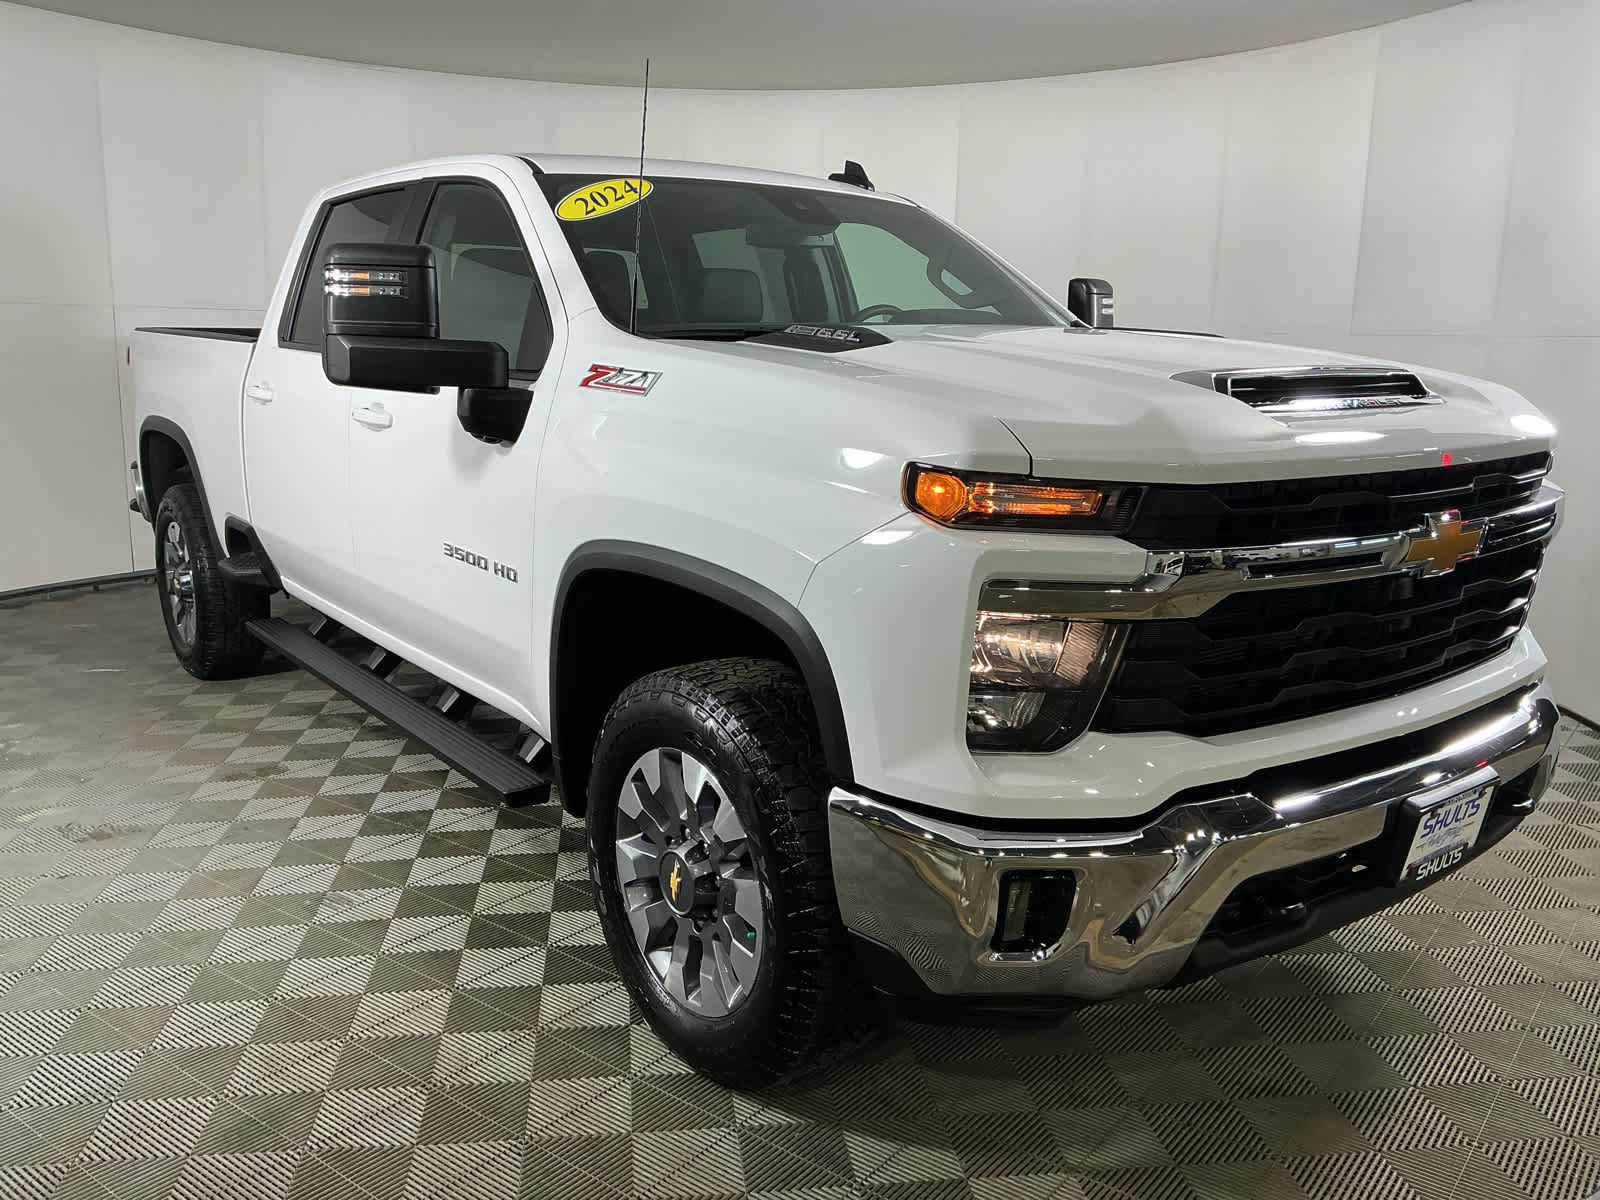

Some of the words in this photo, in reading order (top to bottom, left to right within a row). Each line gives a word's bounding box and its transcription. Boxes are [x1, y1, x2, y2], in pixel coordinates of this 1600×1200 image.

[574, 179, 638, 215] 2024
[580, 364, 663, 397] Z71
[443, 542, 489, 572] 3500
[493, 560, 519, 584] HD
[1420, 796, 1482, 839] SHULTS
[1415, 846, 1465, 881] SHULTS
